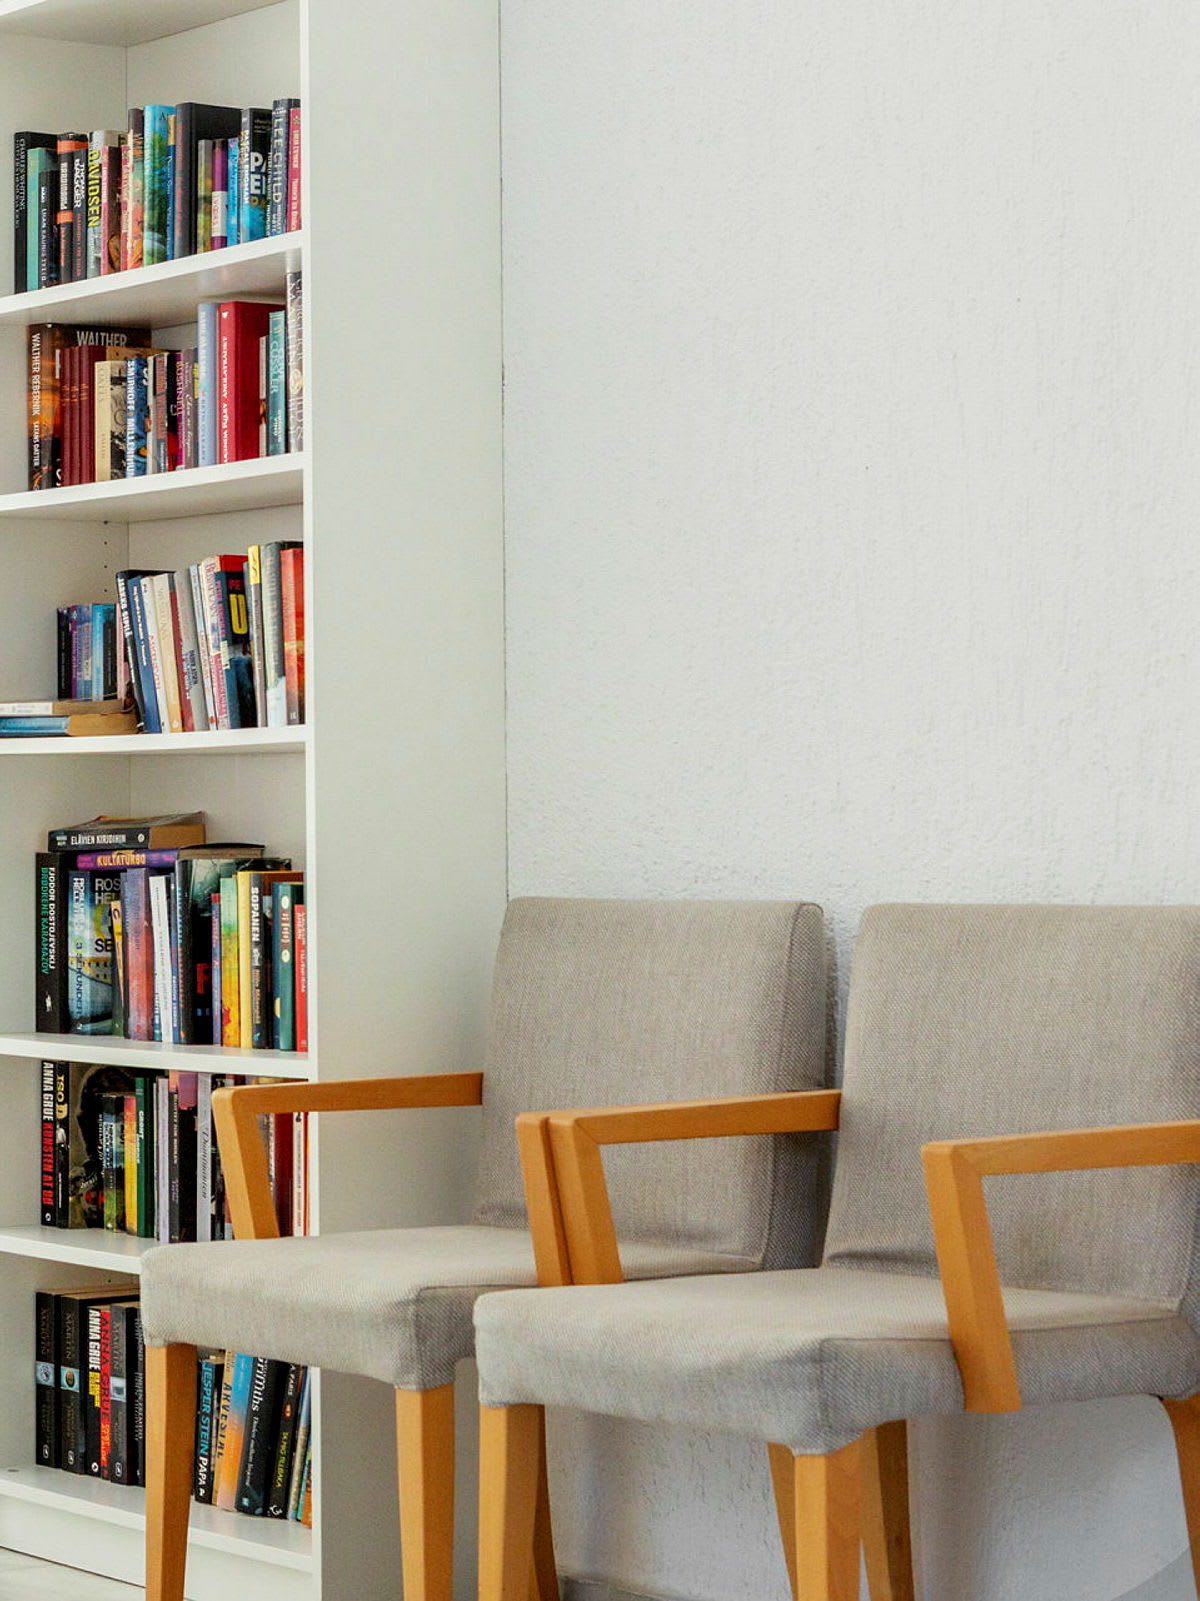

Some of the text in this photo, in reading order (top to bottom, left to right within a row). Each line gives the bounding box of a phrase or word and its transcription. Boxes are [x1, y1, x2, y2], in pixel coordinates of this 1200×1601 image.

[273, 118, 284, 149] LEE
[88, 149, 101, 228] DAVIDSEN
[273, 152, 283, 203] CHILD
[31, 333, 41, 416] WALTHER REBERNIK
[127, 360, 136, 411] SMIRNOFF
[48, 867, 56, 970] FJODOR DOSTOJEVSKIJ
[251, 887, 260, 941] SOPANEN
[40, 918, 49, 975] KARAMAZOV
[75, 953, 83, 1015] SEKUNDER
[42, 1062, 54, 1091] ANNA
[56, 1074, 65, 1103] ISO
[42, 1093, 54, 1122] GRUE
[42, 1122, 54, 1172] KUNSTEN
[42, 1174, 54, 1188] AT
[40, 1308, 48, 1356] MARTIN
[64, 1312, 72, 1360] MARTIN
[89, 1309, 101, 1340] ANNA
[112, 1320, 120, 1369] MARTIN
[89, 1341, 101, 1371] GRUE
[100, 1316, 111, 1418] ANNA GRUE
[198, 1362, 213, 1485] JESPER STEIN PAPA
